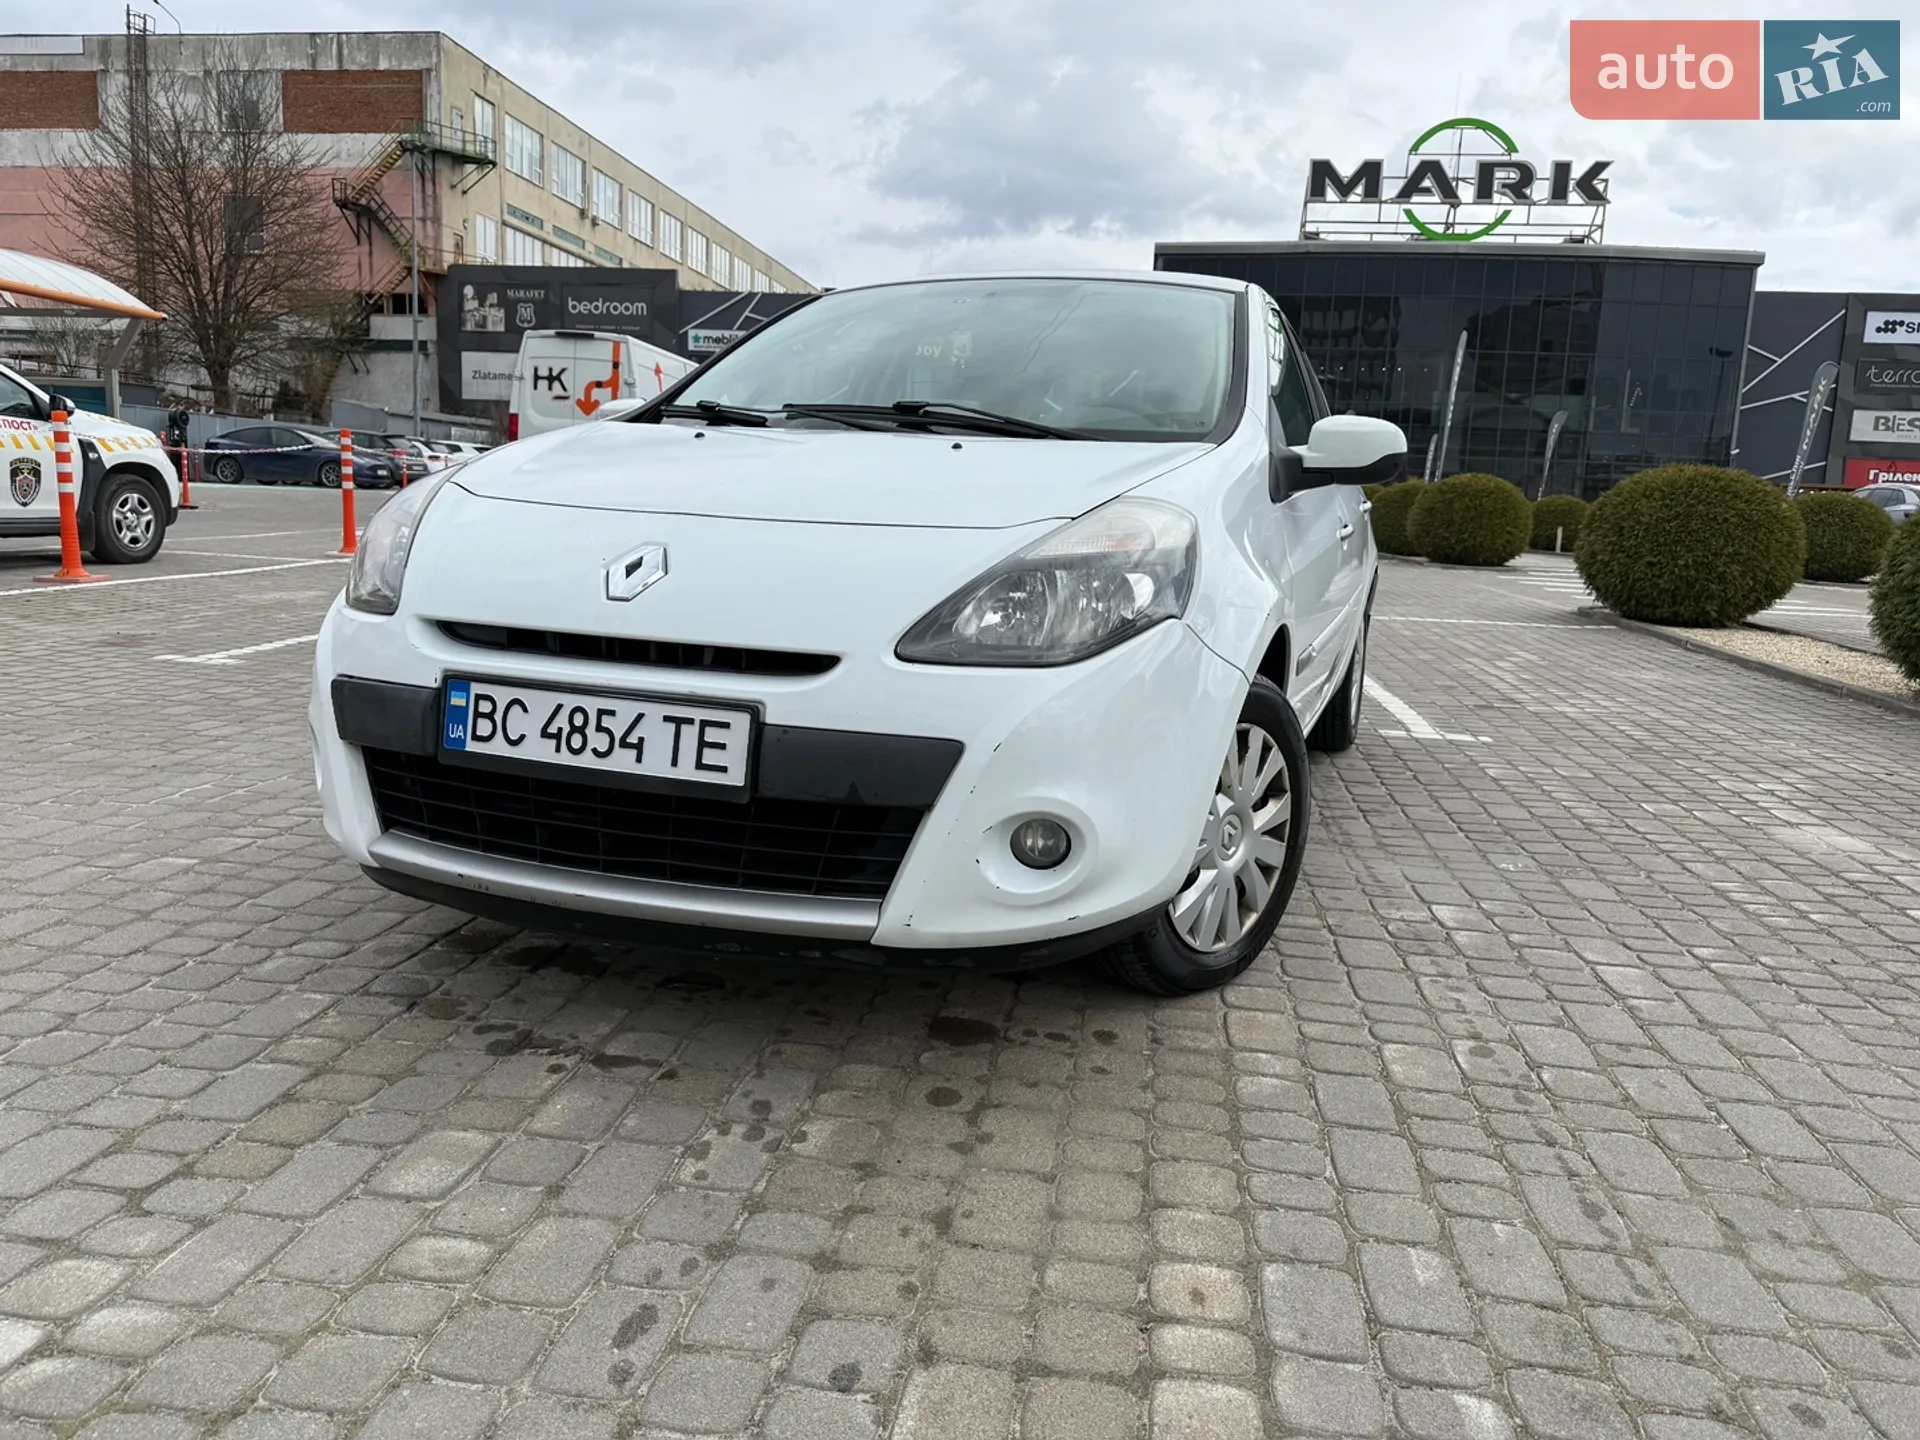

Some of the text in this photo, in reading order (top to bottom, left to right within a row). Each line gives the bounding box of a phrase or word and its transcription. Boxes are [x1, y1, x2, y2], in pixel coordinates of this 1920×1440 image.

[1308, 158, 1616, 204] MARK
[568, 297, 647, 316] bedroom
[448, 722, 466, 740] UA
[471, 692, 732, 774] BC 4854 TE
